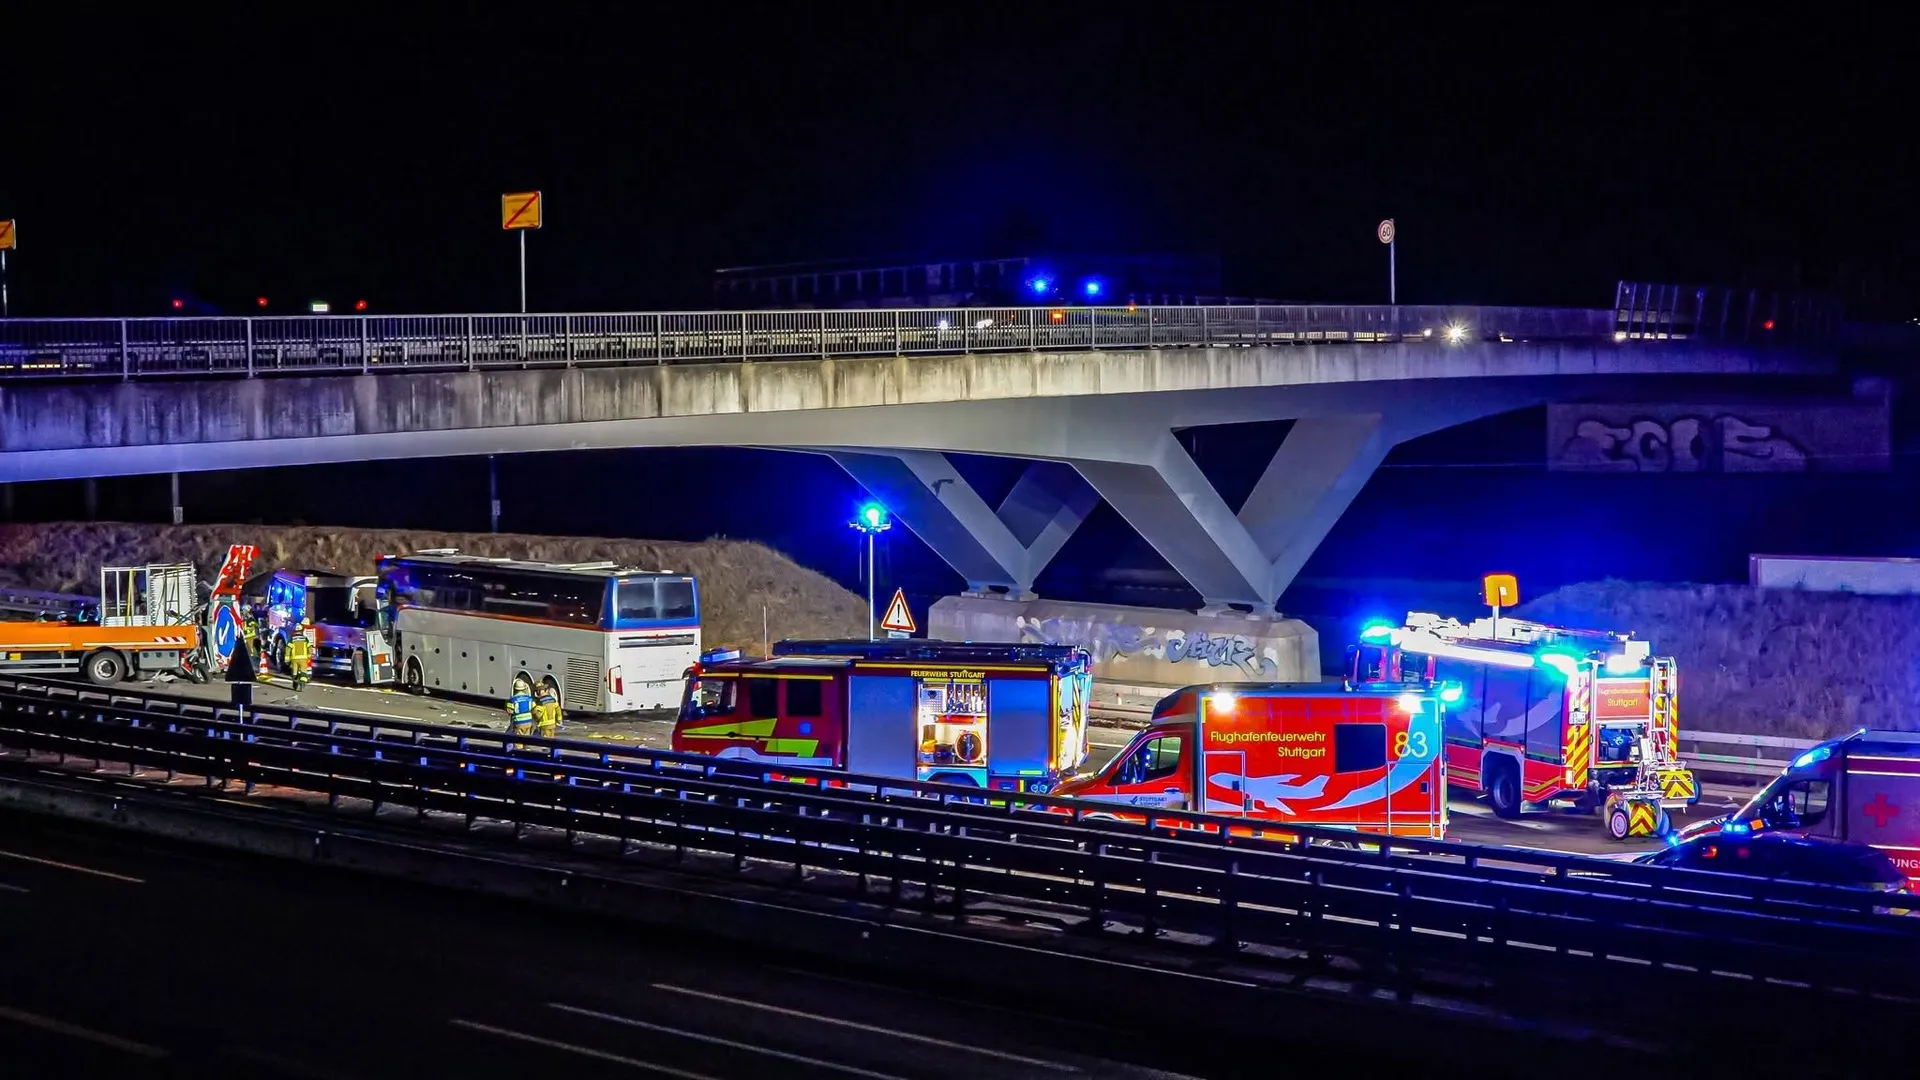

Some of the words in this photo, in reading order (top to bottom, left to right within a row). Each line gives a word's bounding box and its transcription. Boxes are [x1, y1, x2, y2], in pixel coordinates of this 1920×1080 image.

[1382, 226, 1390, 237] 60
[949, 669, 985, 678] STUTTGART
[1607, 698, 1639, 707] Stuttgart
[1210, 731, 1326, 744] Flughafenfeuerwehr
[1394, 731, 1428, 758] 83
[1278, 746, 1326, 759] Stuttgart
[1888, 857, 1920, 869] UNG
